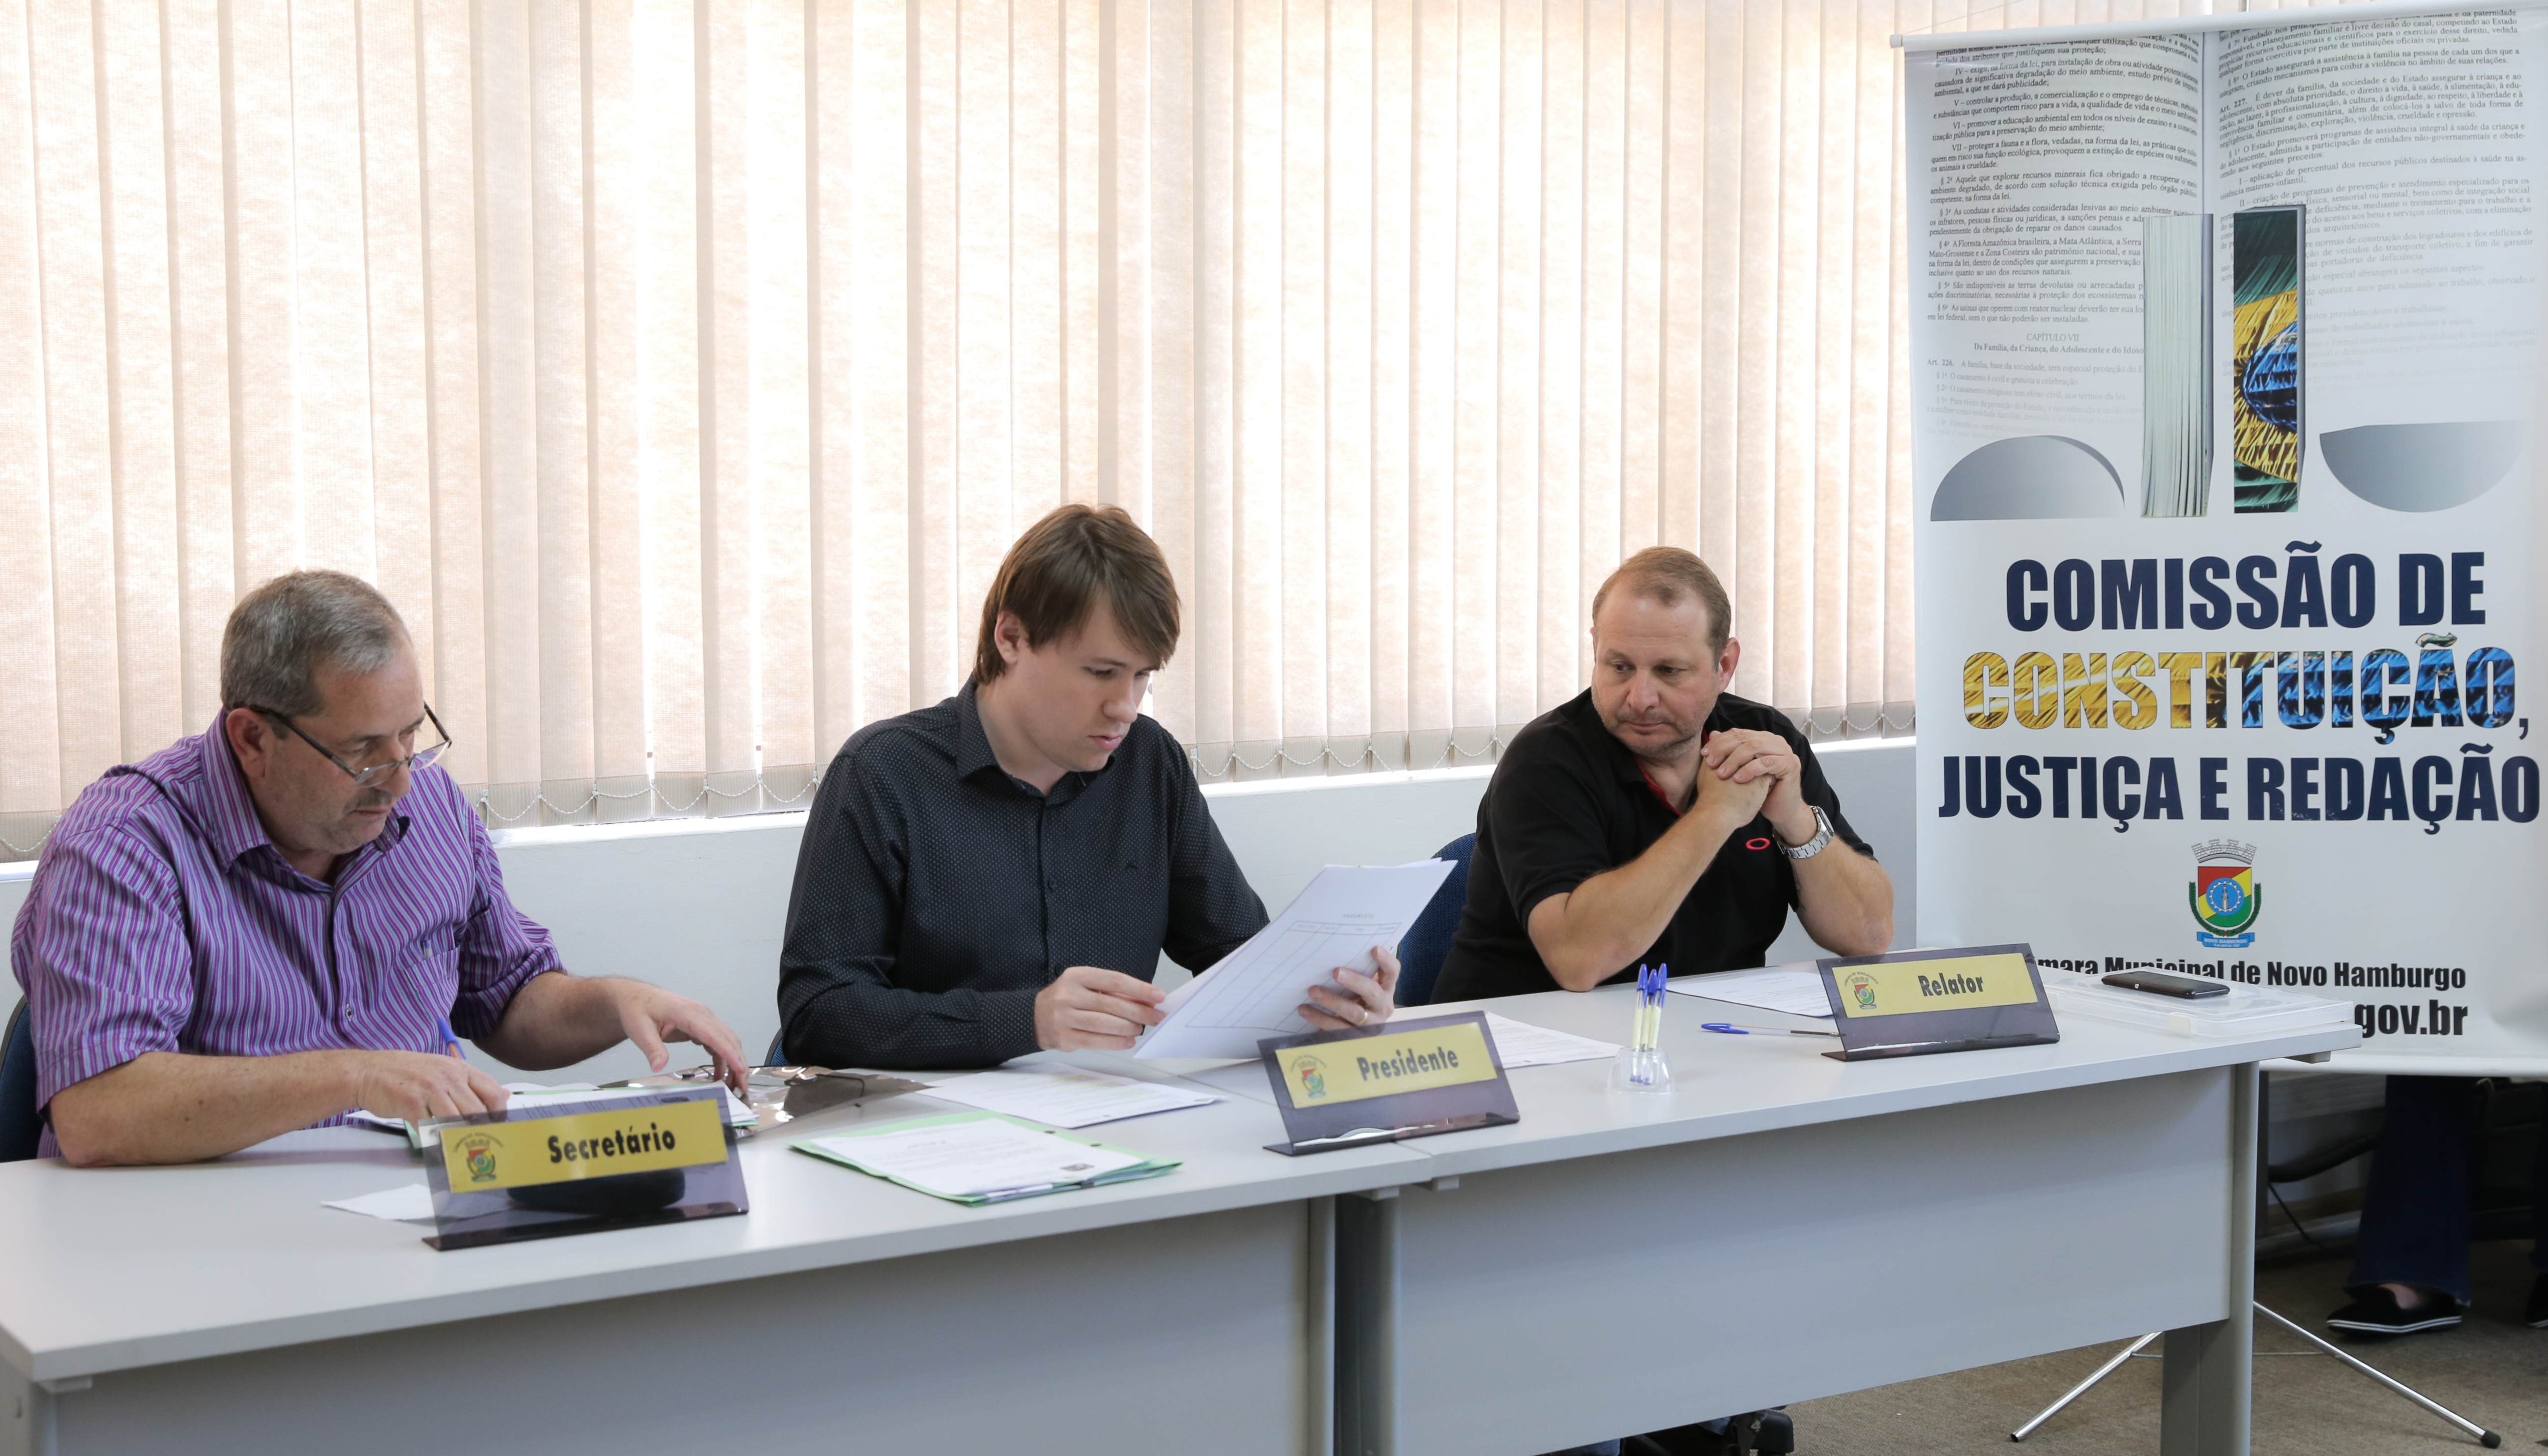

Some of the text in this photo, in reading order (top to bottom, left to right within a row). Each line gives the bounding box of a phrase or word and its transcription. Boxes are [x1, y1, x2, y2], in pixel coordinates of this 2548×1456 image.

[2219, 63, 2243, 79] qualquer
[2244, 58, 2264, 67] forma
[2265, 49, 2302, 61] coercitiva
[2303, 47, 2316, 56] por
[2318, 44, 2338, 53] parte
[2351, 38, 2394, 47] instituições
[2437, 35, 2471, 45] privadas.
[2246, 75, 2272, 87] criando
[2274, 68, 2320, 81] mecanismos
[2321, 66, 2339, 74] para
[2340, 61, 2363, 70] coibir
[2372, 59, 2406, 67] violência
[2476, 56, 2508, 65] relações.
[1934, 87, 1964, 97] ambiental,
[1970, 86, 1982, 94] que
[2007, 79, 2049, 90] publicidade;
[1932, 132, 1953, 142] tização
[1953, 130, 1975, 141] pública
[1976, 130, 1991, 139] para
[1996, 125, 2037, 137] preservação
[2069, 123, 2105, 132] ambiente;
[2219, 124, 2255, 139] convivência
[2257, 116, 2285, 127] familiar
[2296, 108, 2344, 120] comunitária,
[2383, 102, 2423, 111] colocá-los
[2434, 100, 2454, 109] salvo
[2220, 132, 2255, 149] negligência,
[2255, 122, 2309, 137] discriminação,
[2311, 116, 2356, 128] exploração,
[2358, 113, 2396, 122] violência,
[2397, 111, 2434, 119] crueldade
[2442, 111, 2477, 119] opressão.
[2251, 140, 2275, 151] Estado
[2277, 132, 2318, 146] promoverá
[2320, 130, 2362, 141] programas
[2375, 125, 2417, 134] assistência
[2419, 124, 2448, 133] integral
[2491, 124, 2519, 133] criança
[1938, 164, 1961, 172] animais
[1966, 160, 1998, 169] crueldade.
[2252, 158, 2284, 170] seguintes
[2287, 152, 2324, 164] preceitos:
[2245, 175, 2306, 192] materno-infantil;
[1929, 228, 1971, 237] pendentemente
[1982, 226, 2014, 234] obrigação
[2088, 223, 2124, 232] causados.
[2018, 237, 2051, 246] brasileira,
[2079, 237, 2114, 246] Atlântica,
[2122, 237, 2142, 246] Serra
[1984, 343, 2009, 352] Família,
[2019, 345, 2048, 354] Criança,
[2026, 332, 2067, 341] CAPÍTULO
[2006, 540, 2486, 631] COMISSÃO DE
[1963, 633, 2529, 745] CONSTITUIÇÃO,
[1938, 742, 2540, 835] JUSTIÇA E REDAÇÃO
[1917, 972, 1983, 996] Relator
[2038, 959, 2098, 974] mara
[2231, 961, 2261, 985] de
[2267, 961, 2327, 987] Novo
[2334, 962, 2466, 991] Hamburgo
[2354, 999, 2468, 1038] gov.br
[1357, 1046, 1459, 1081] Presidente
[548, 1122, 675, 1164] Secretário
